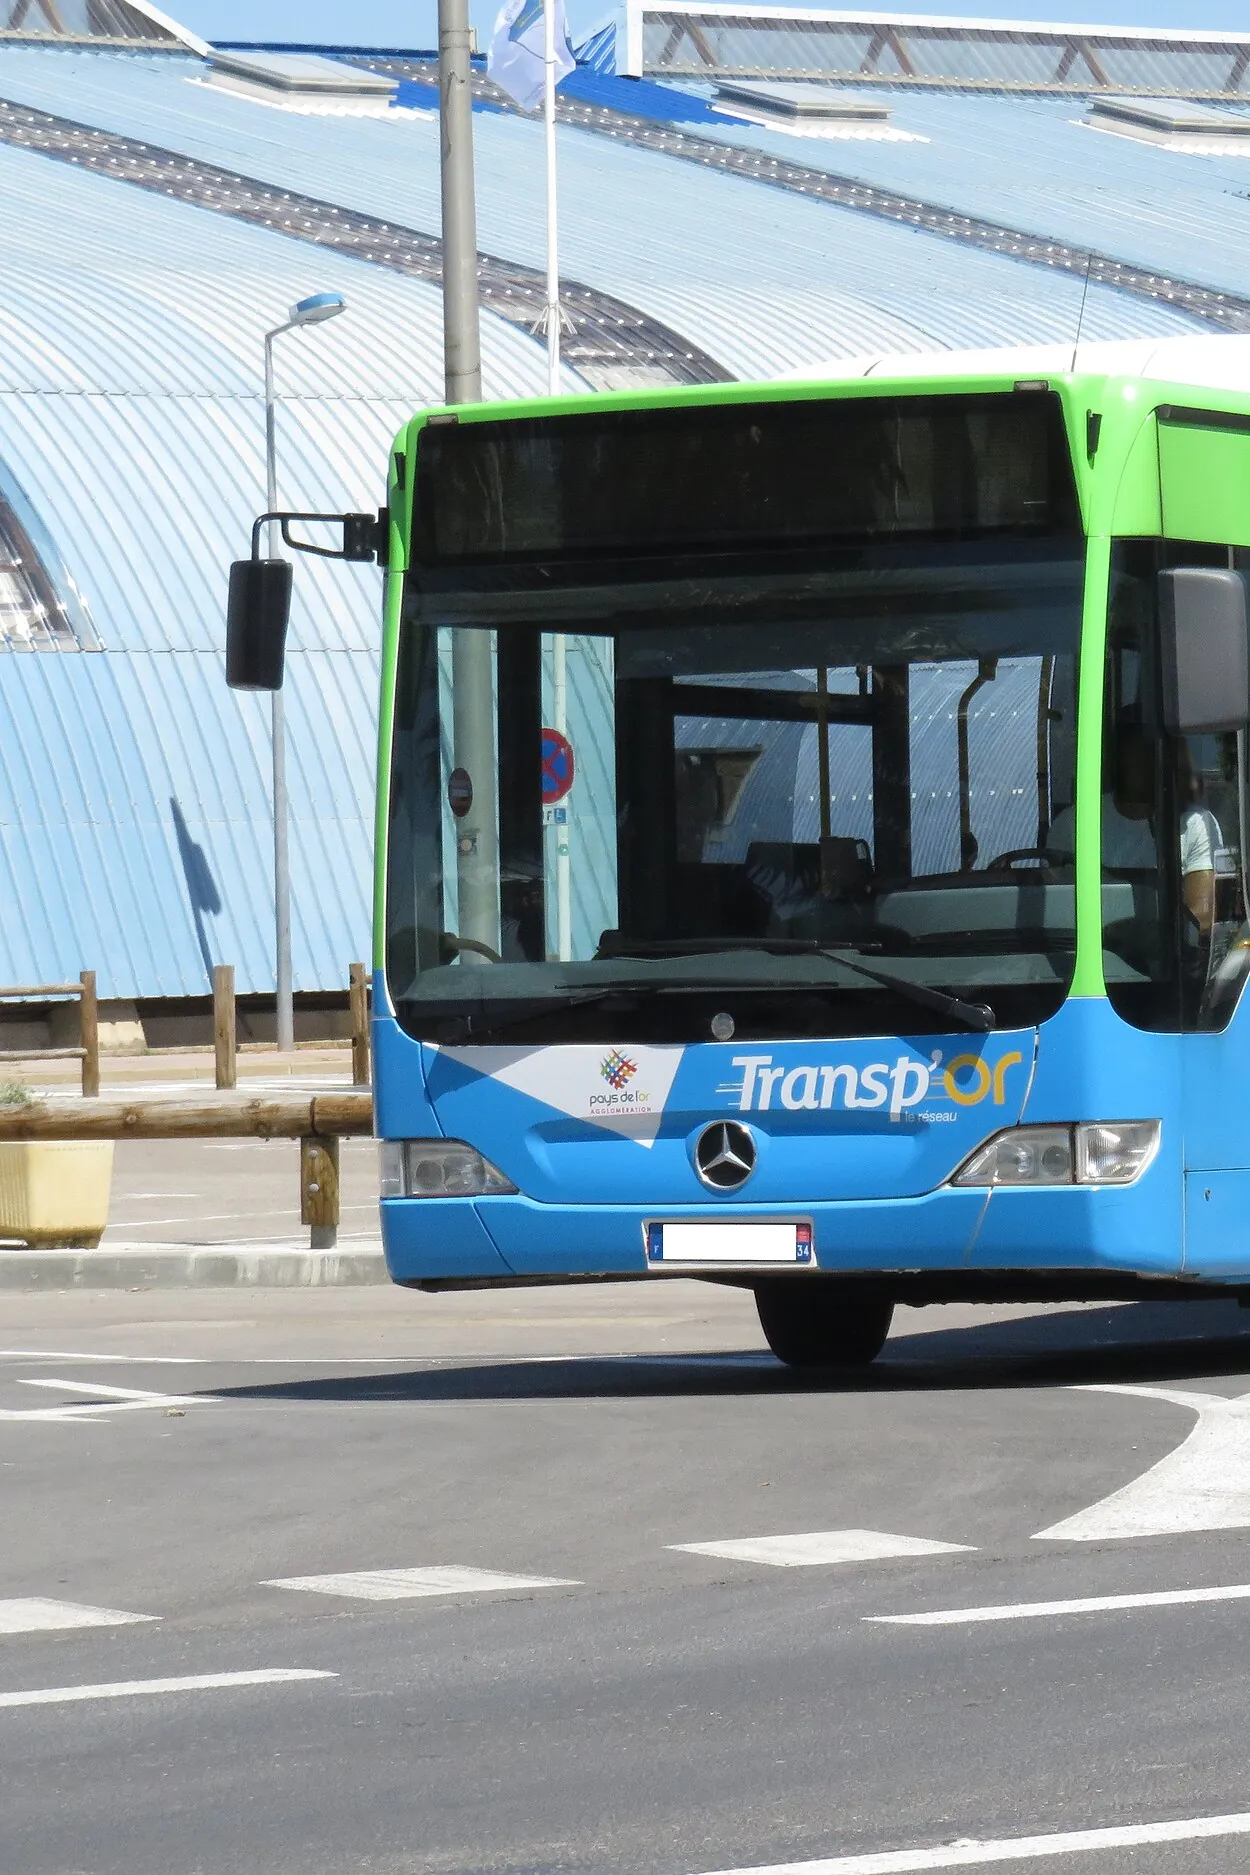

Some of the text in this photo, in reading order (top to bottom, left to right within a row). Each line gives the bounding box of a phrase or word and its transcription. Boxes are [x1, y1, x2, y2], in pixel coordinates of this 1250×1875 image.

[589, 1090, 650, 1107] pays de l'or
[905, 1110, 957, 1123] le réseau
[796, 1244, 809, 1257] 34
